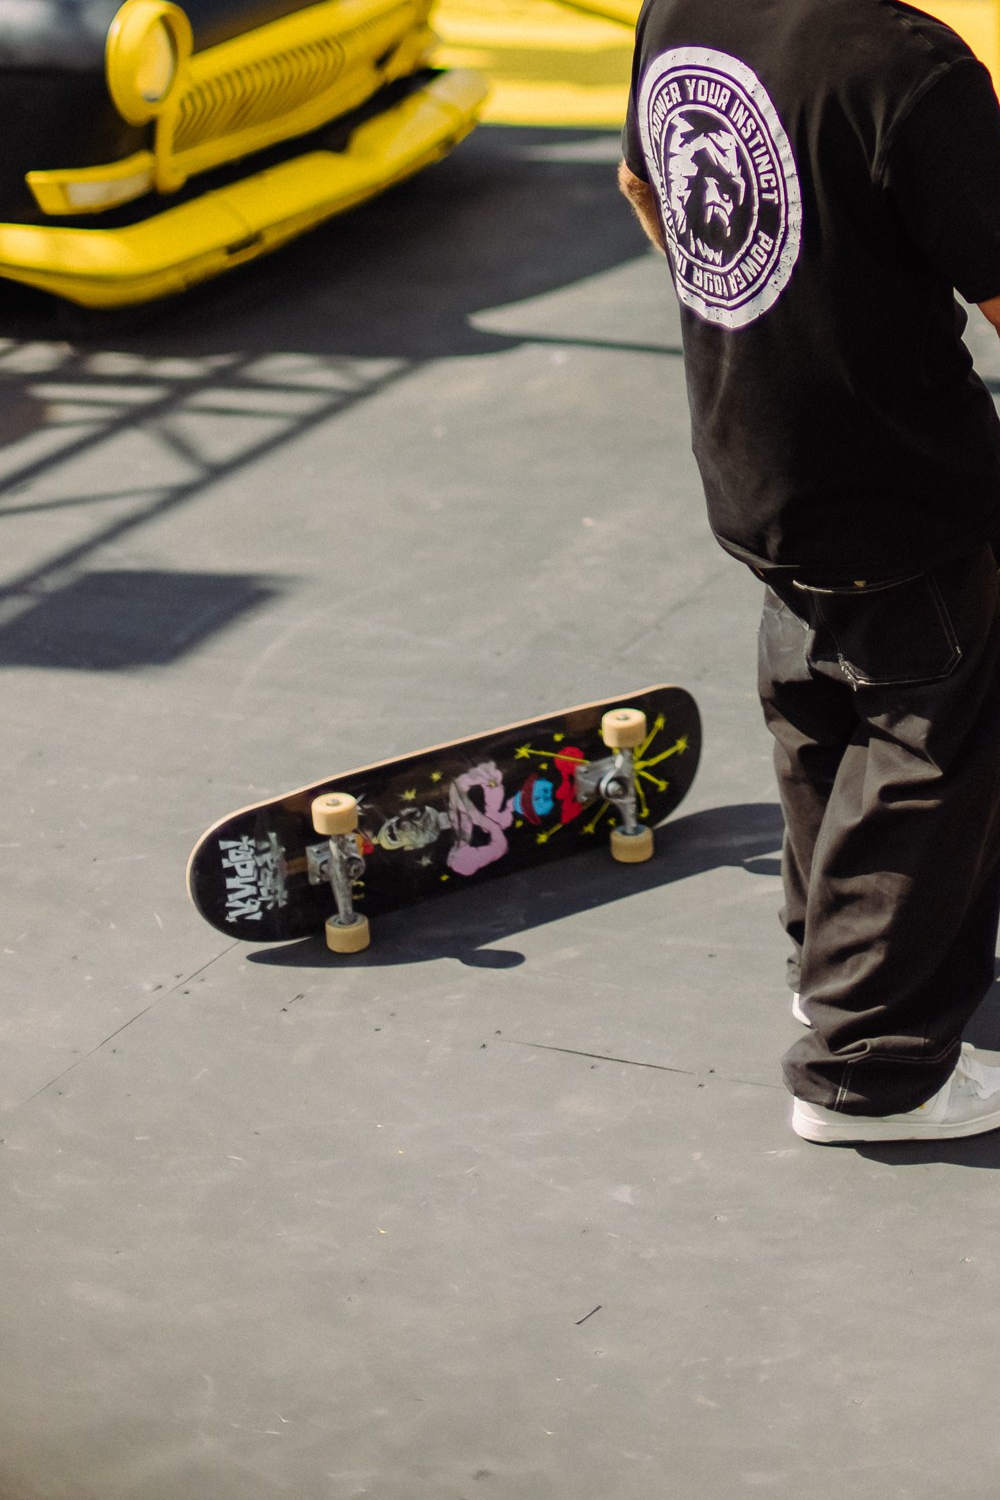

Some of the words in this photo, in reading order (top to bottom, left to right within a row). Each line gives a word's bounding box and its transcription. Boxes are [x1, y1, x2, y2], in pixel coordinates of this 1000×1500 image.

[652, 81, 682, 145] POWER
[685, 78, 731, 111] YOUR
[729, 98, 779, 204] INSTINCT
[727, 230, 773, 293] POWER
